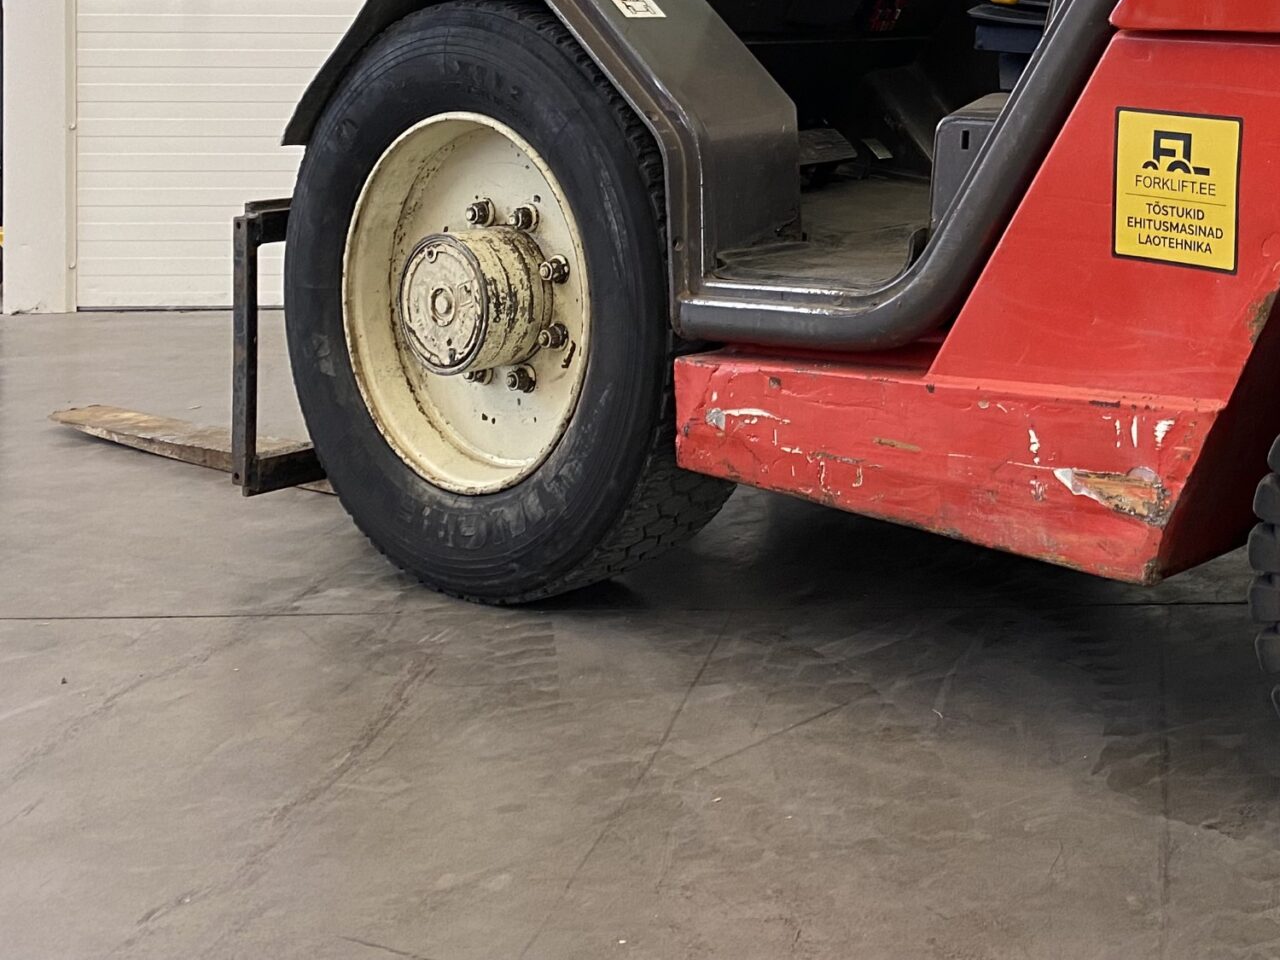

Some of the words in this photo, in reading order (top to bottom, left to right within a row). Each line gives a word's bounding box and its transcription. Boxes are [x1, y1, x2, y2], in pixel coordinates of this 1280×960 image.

[1134, 174, 1217, 197] FORKLIFT.EE
[1145, 201, 1206, 221] TÕSTUKID
[1127, 216, 1224, 240] EHITUSMASINAD
[1138, 233, 1213, 255] LAOTEHNIKA
